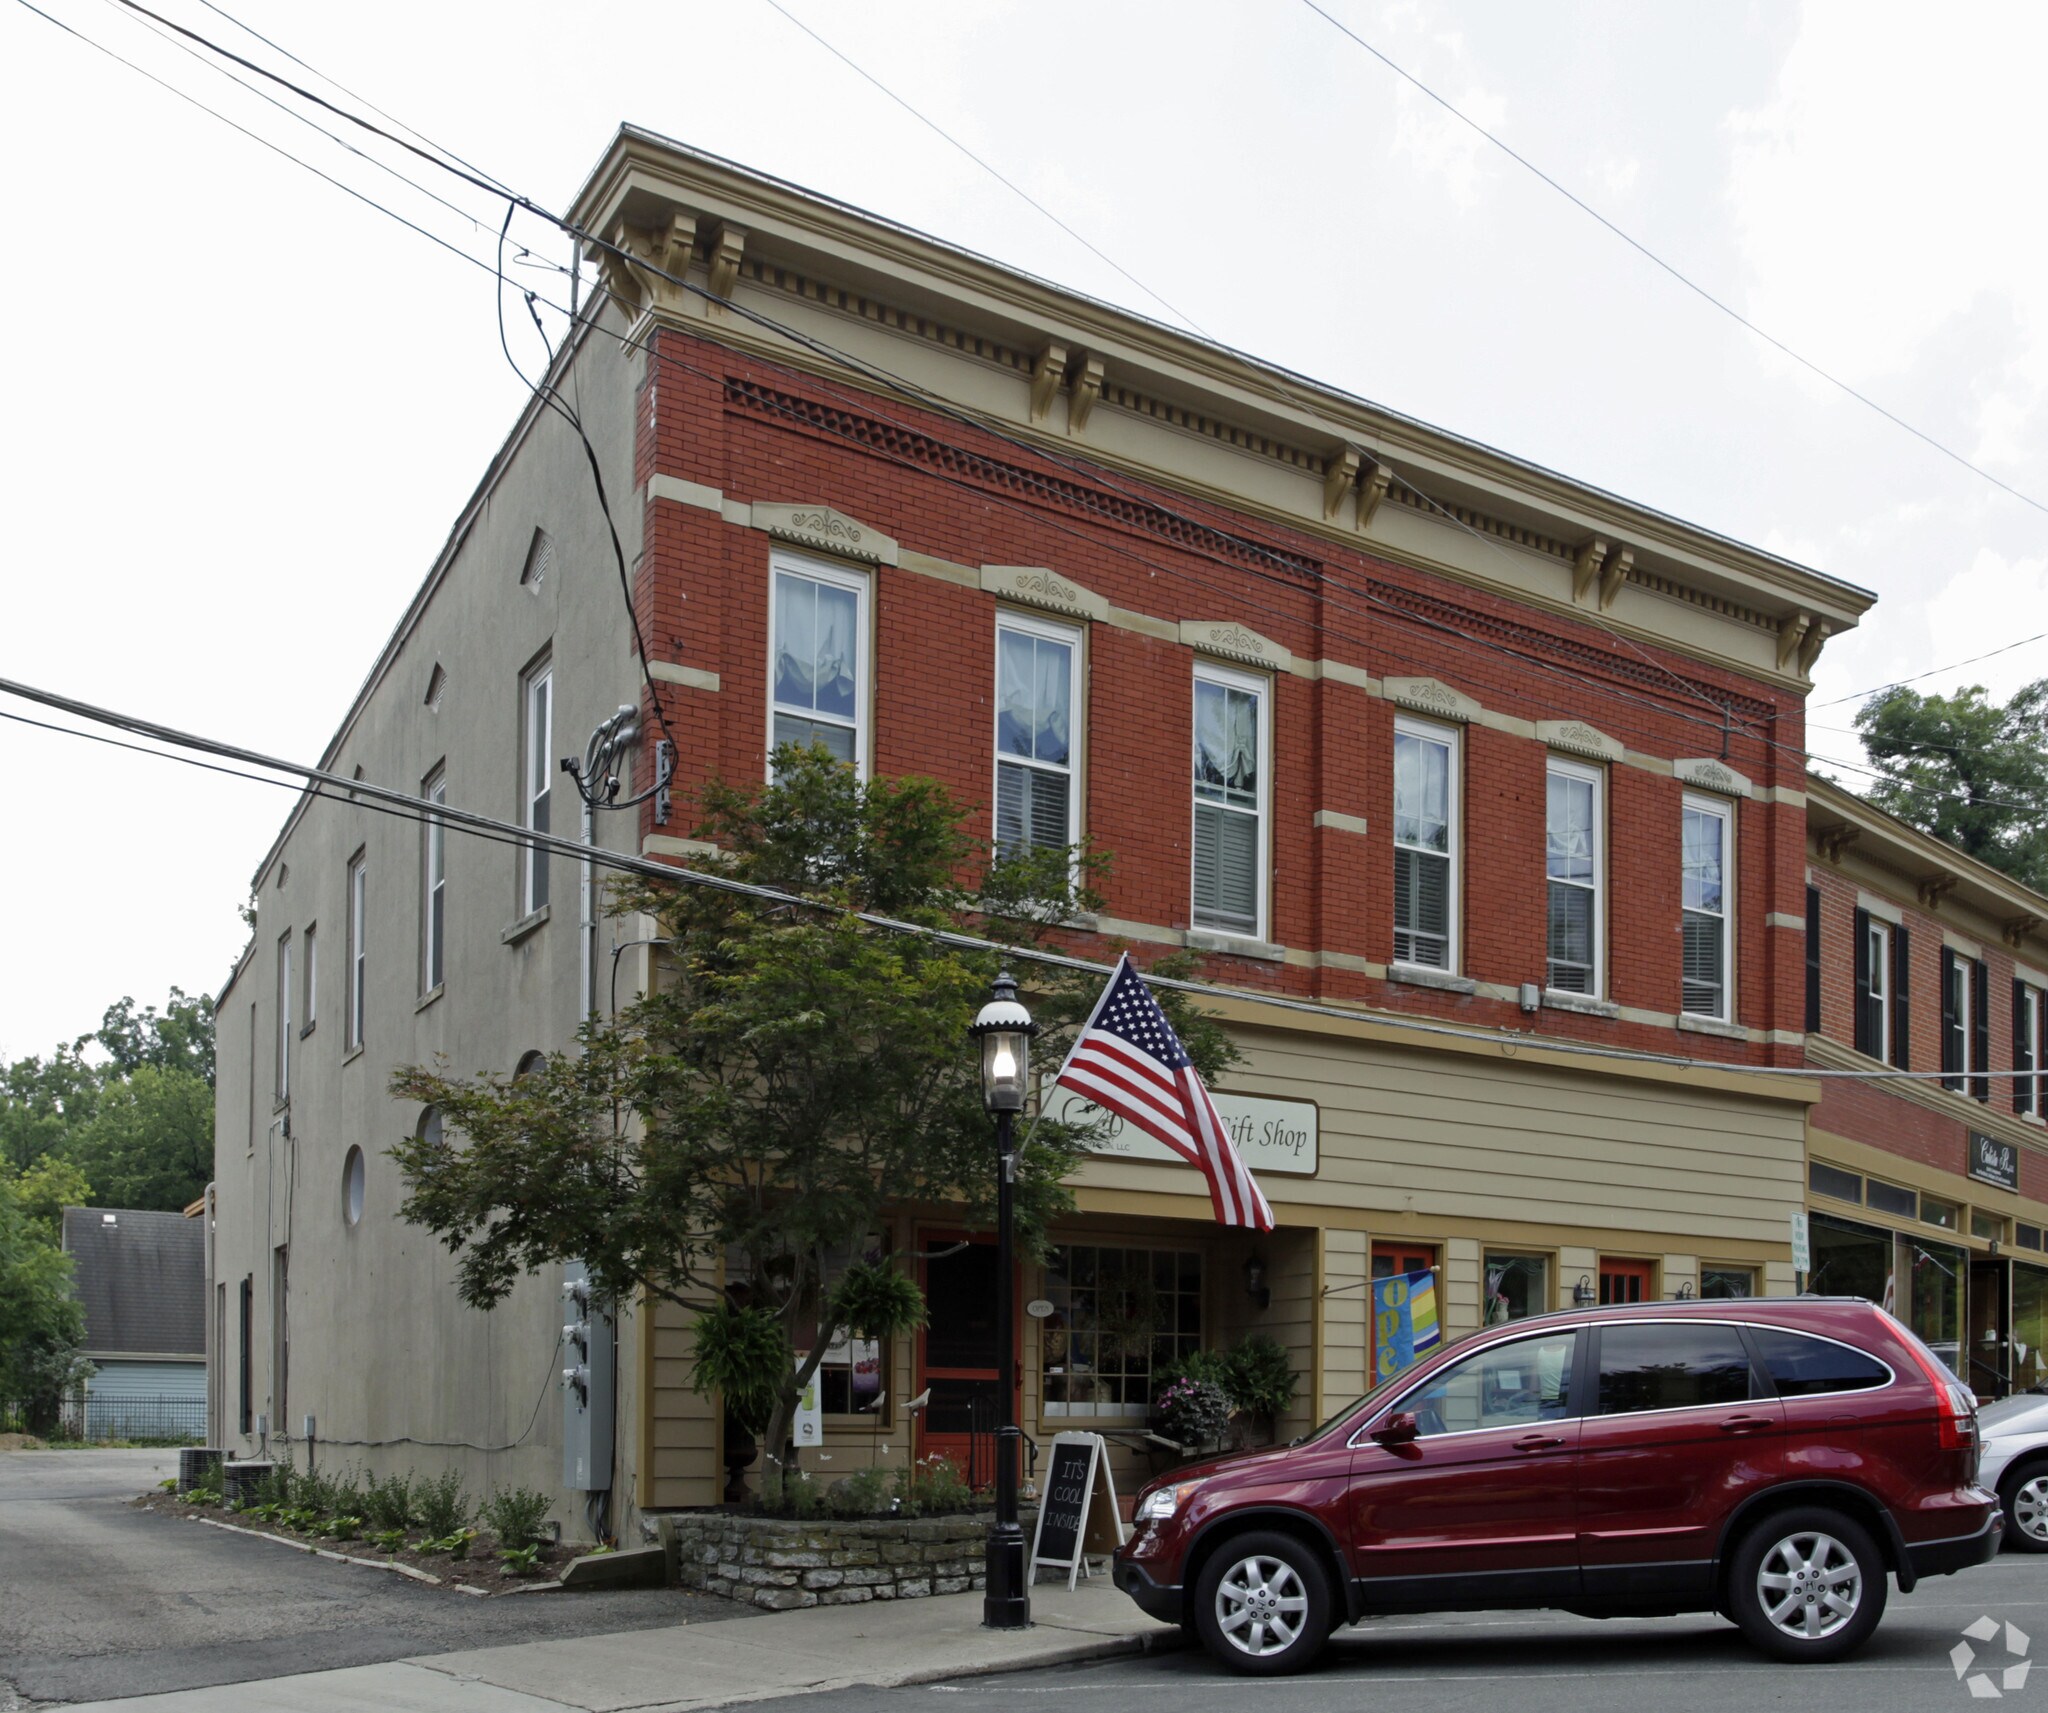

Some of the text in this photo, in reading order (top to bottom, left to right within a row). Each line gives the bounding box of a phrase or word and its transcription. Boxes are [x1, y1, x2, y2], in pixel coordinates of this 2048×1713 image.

[1116, 1143, 1130, 1152] LLC
[1258, 1119, 1308, 1157] Shop
[1062, 1459, 1086, 1480] IT'S
[1054, 1486, 1082, 1504] COOL
[1045, 1511, 1081, 1532] INSIDE
